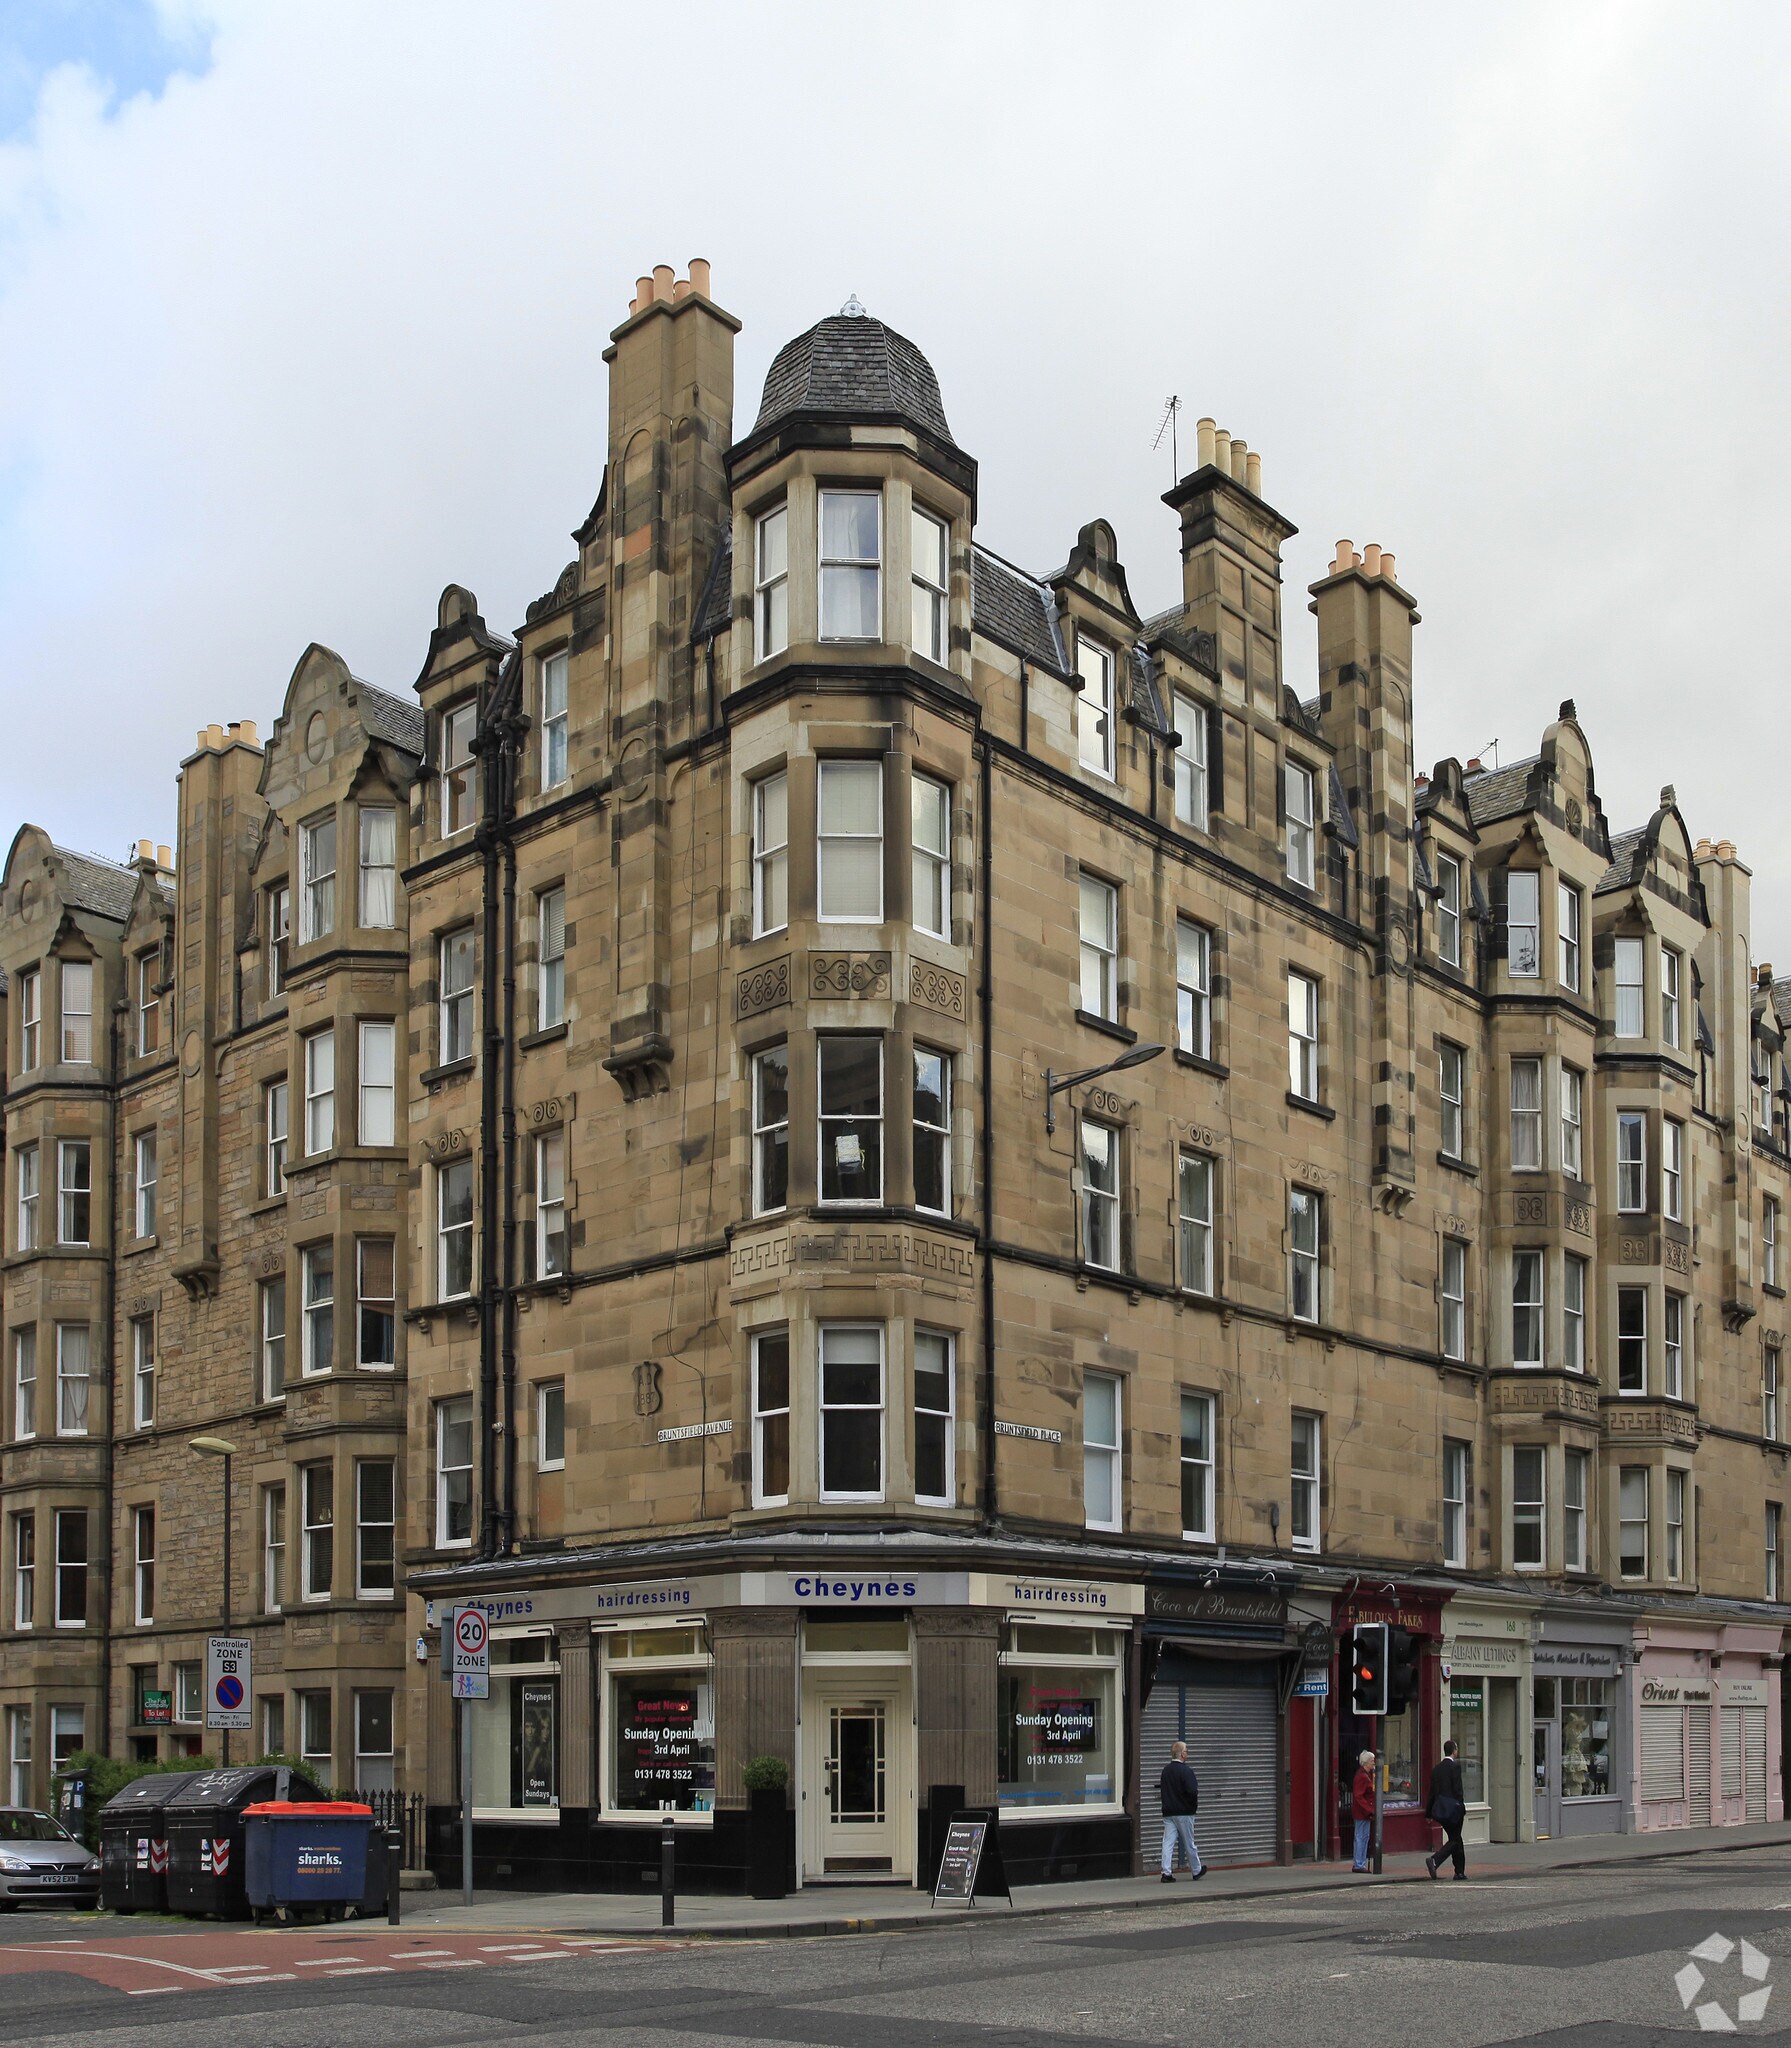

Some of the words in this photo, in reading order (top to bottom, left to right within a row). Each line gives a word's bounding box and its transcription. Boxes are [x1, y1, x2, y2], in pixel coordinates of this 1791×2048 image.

[658, 1426, 703, 1441] BRUNTSFIELD
[705, 1421, 732, 1434] AVENUE
[995, 1422, 1039, 1439] BRUNTSFIELD
[1041, 1429, 1060, 1442] PLACE
[794, 1577, 916, 1601] Cheynes
[597, 1588, 690, 1607] hairdressing
[1014, 1585, 1106, 1607] hairdressing
[1151, 1590, 1181, 1611] Coco
[1187, 1596, 1204, 1616] of
[1207, 1594, 1283, 1619] Bruntsfield
[460, 1623, 482, 1641] 20
[1507, 1620, 1516, 1632] 168
[211, 1640, 248, 1648] Controlled
[216, 1649, 242, 1659] ZONE
[1450, 1645, 1482, 1661] ALBANY
[1483, 1647, 1517, 1662] LETTINGS
[457, 1655, 486, 1666] ZONE
[224, 1662, 236, 1672] S3
[1304, 1684, 1327, 1692] Rent
[1642, 1682, 1679, 1701] Orient
[524, 1692, 551, 1703] Cheynes
[637, 1701, 661, 1711] Great
[1015, 1714, 1052, 1728] Sunday
[1054, 1713, 1094, 1728] Opening
[624, 1727, 660, 1742] Sunday
[662, 1727, 704, 1742] Opening
[1046, 1731, 1060, 1741] 3rd
[1062, 1730, 1082, 1742] April
[654, 1744, 668, 1755] 3rd
[670, 1744, 690, 1757] April
[1027, 1755, 1047, 1766] 0131
[1048, 1755, 1063, 1765] 478
[1064, 1754, 1084, 1764] 3522
[634, 1769, 653, 1780] 0131
[655, 1769, 671, 1780] 478
[672, 1769, 693, 1781] 3522
[76, 1780, 84, 1792] P
[529, 1778, 545, 1789] Open
[525, 1789, 550, 1799] Sundays
[951, 1831, 971, 1839] Cheynes
[298, 1852, 343, 1865] sharks.
[42, 1875, 62, 1883] KV52
[62, 1875, 77, 1883] EXN
